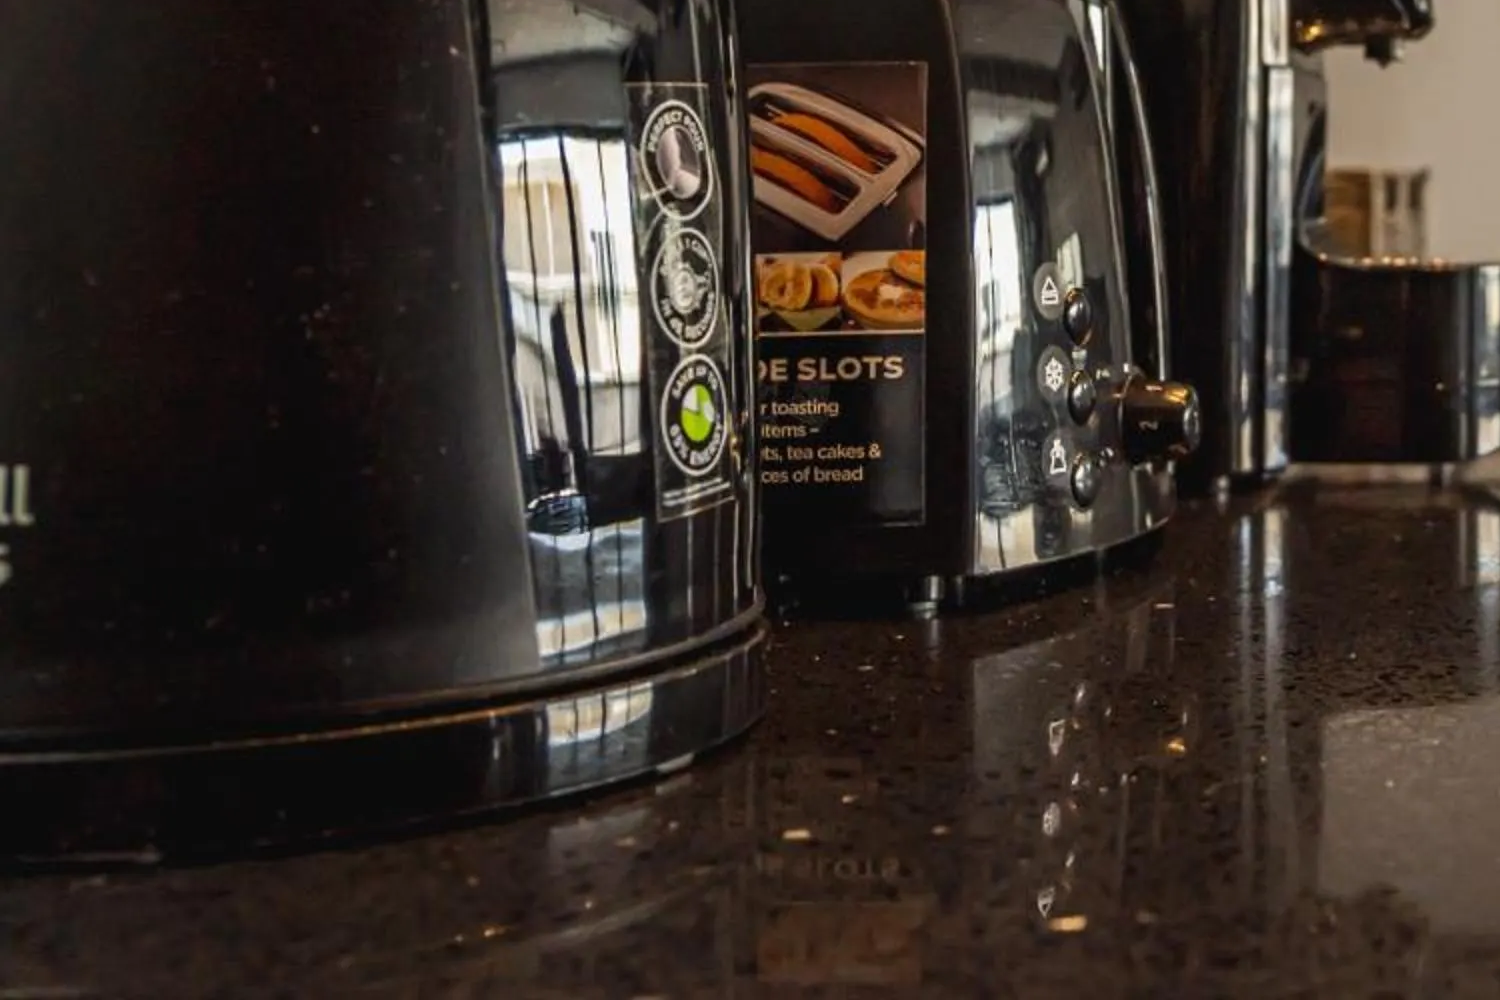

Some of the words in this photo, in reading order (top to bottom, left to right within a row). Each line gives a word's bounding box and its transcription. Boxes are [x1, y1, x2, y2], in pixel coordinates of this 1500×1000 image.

[647, 110, 683, 153] PERFECT
[797, 355, 904, 381] SLOTS
[772, 399, 839, 417] toasting
[761, 424, 807, 438] items
[786, 445, 813, 460] tea
[817, 443, 865, 460] cakes
[868, 442, 882, 459] &
[792, 465, 811, 483] of
[813, 464, 864, 483] bread
